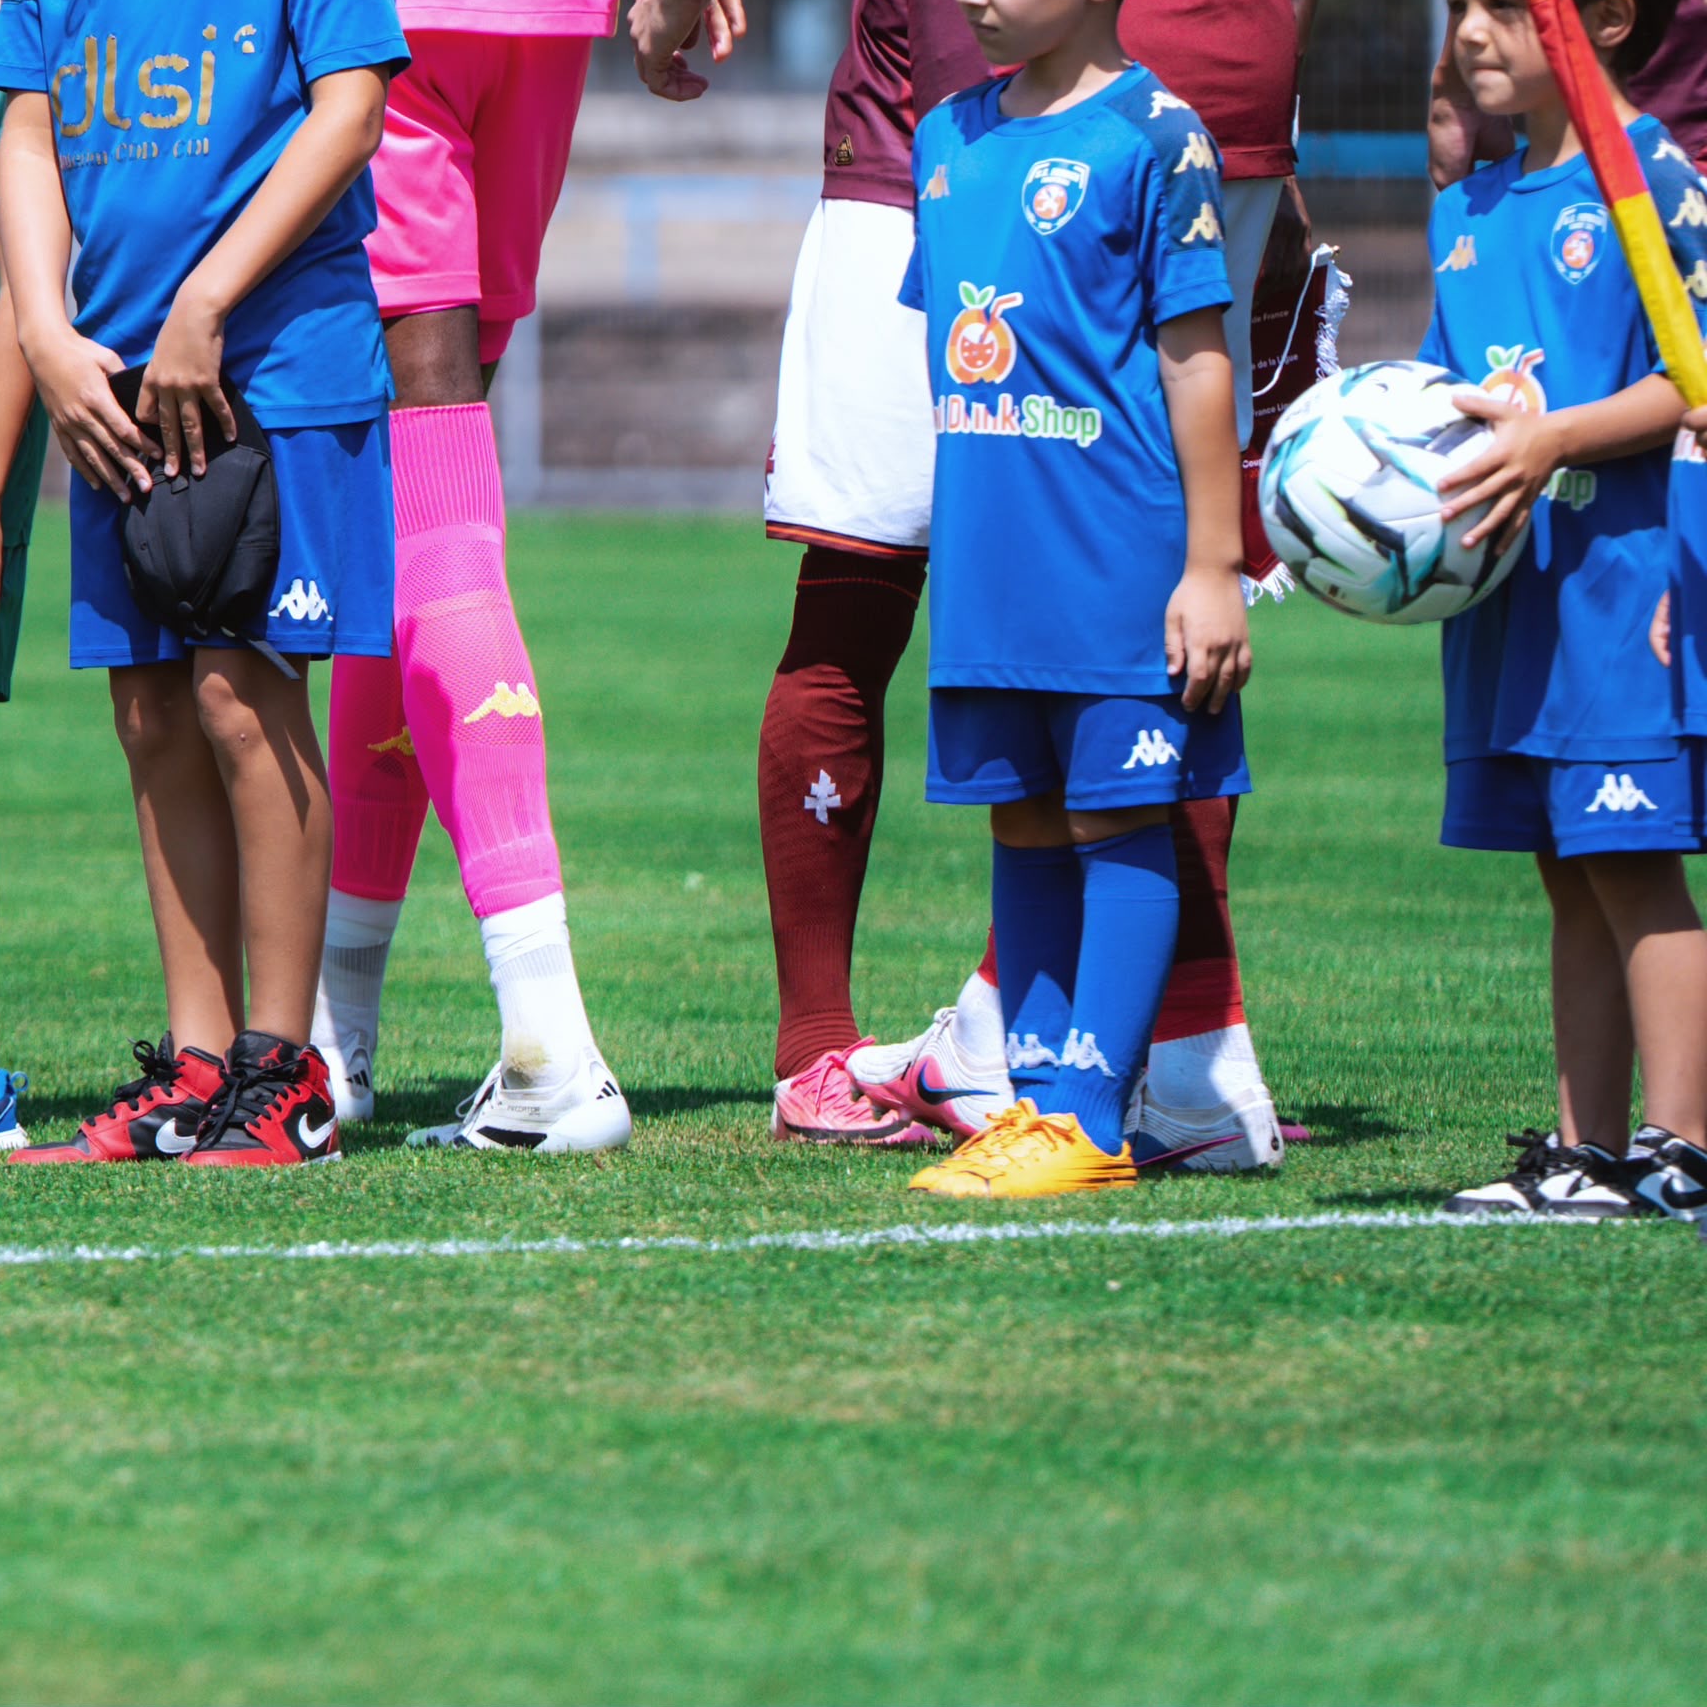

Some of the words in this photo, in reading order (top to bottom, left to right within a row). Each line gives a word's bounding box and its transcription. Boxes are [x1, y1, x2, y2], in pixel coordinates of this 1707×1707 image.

[52, 24, 217, 137] dlsi
[1021, 394, 1102, 448] Shop
[1253, 405, 1277, 417] rance
